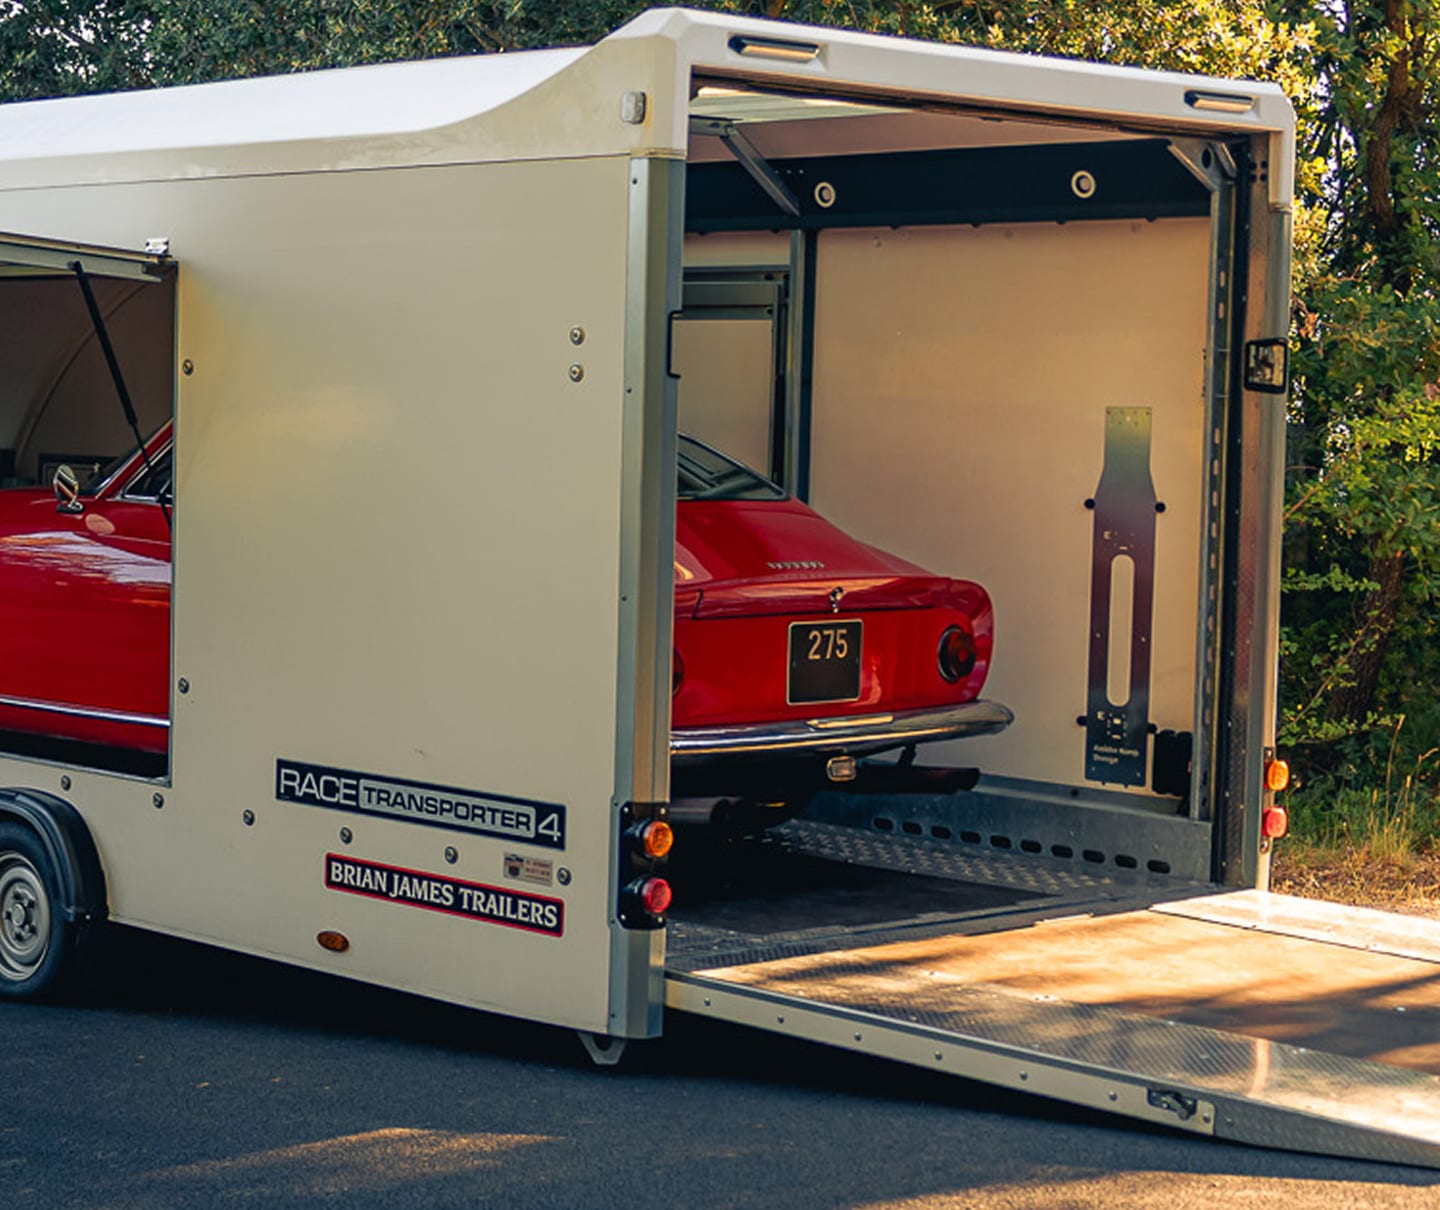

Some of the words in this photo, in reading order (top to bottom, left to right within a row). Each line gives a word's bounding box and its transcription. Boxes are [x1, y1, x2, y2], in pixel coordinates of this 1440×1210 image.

[808, 629, 848, 660] 275
[280, 767, 357, 806] RACE
[363, 786, 531, 833] TRANSPORTER
[538, 813, 562, 842] 4
[331, 861, 387, 893] BRIAN
[388, 873, 454, 906] JAMES
[459, 887, 558, 928] TRAILERS
